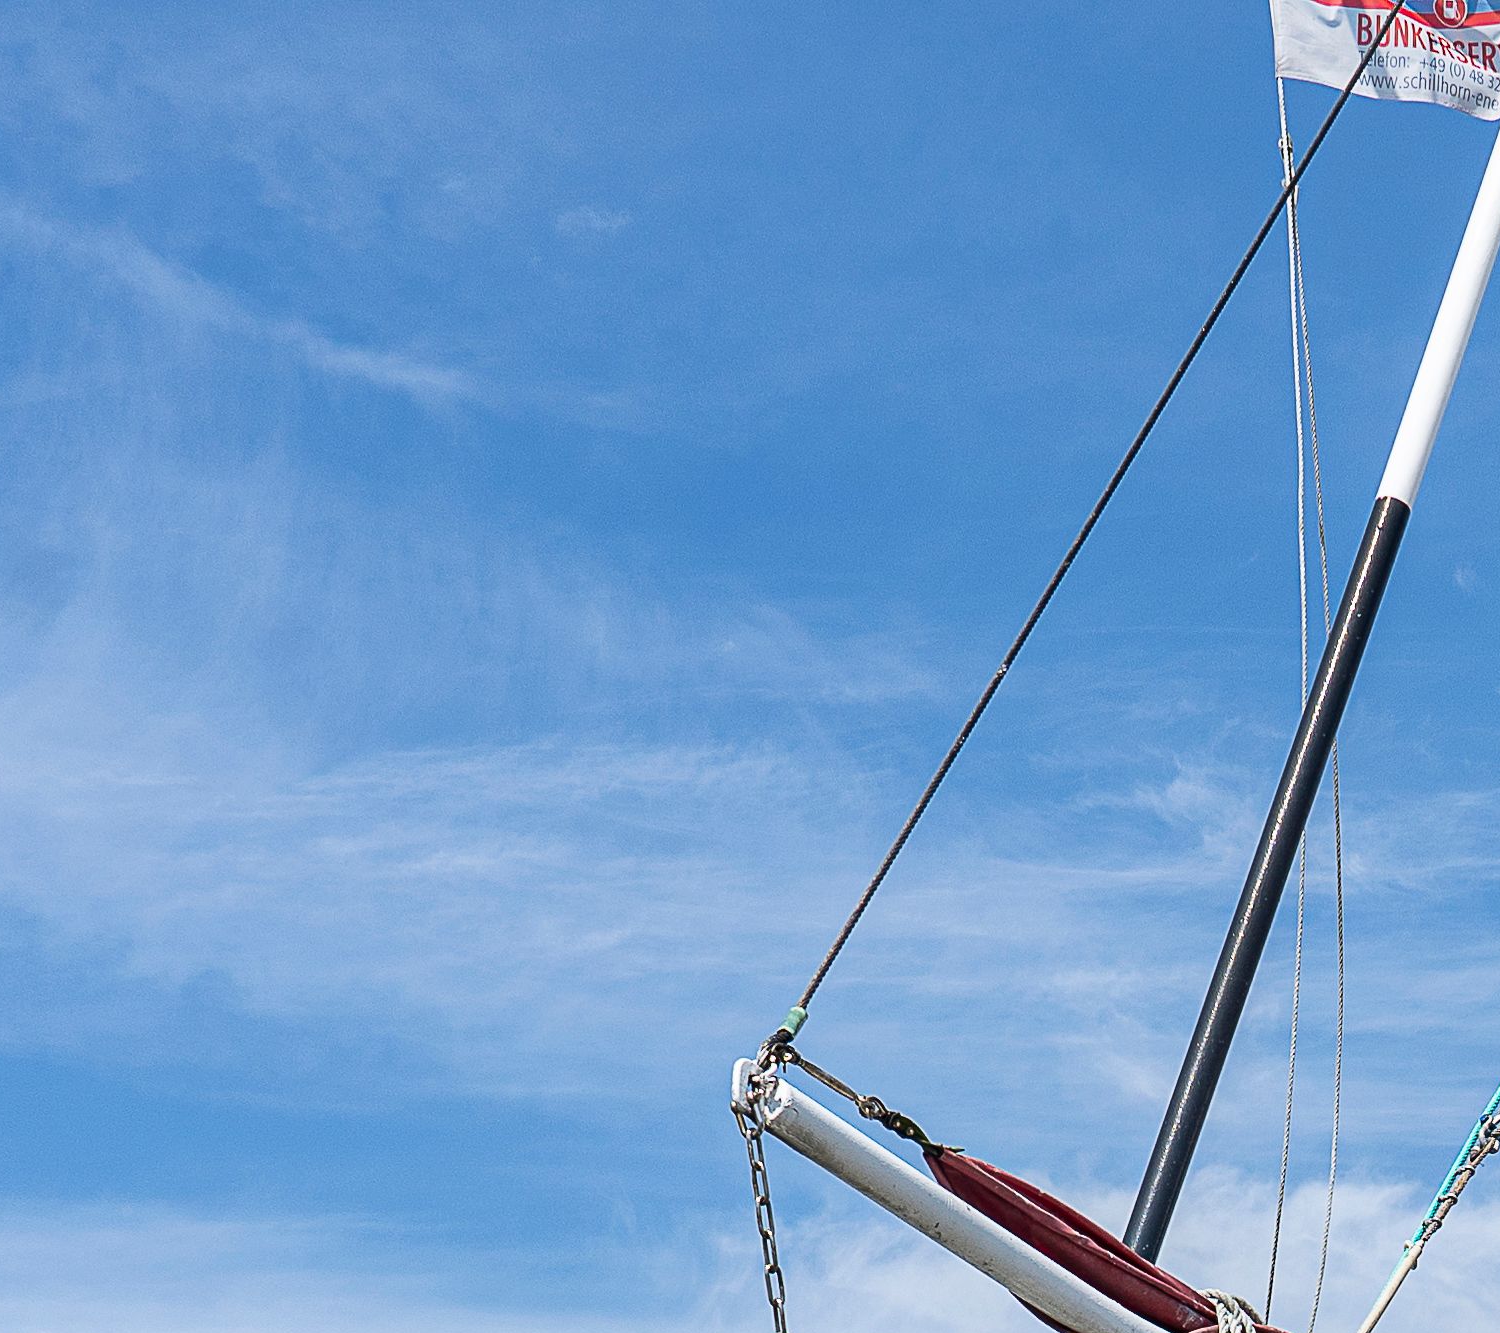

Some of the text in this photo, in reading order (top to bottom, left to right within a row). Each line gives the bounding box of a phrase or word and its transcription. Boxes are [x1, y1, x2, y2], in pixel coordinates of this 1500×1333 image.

[1419, 58, 1445, 73] +49
[1470, 71, 1484, 85] 48
[1488, 77, 1500, 92] 32
